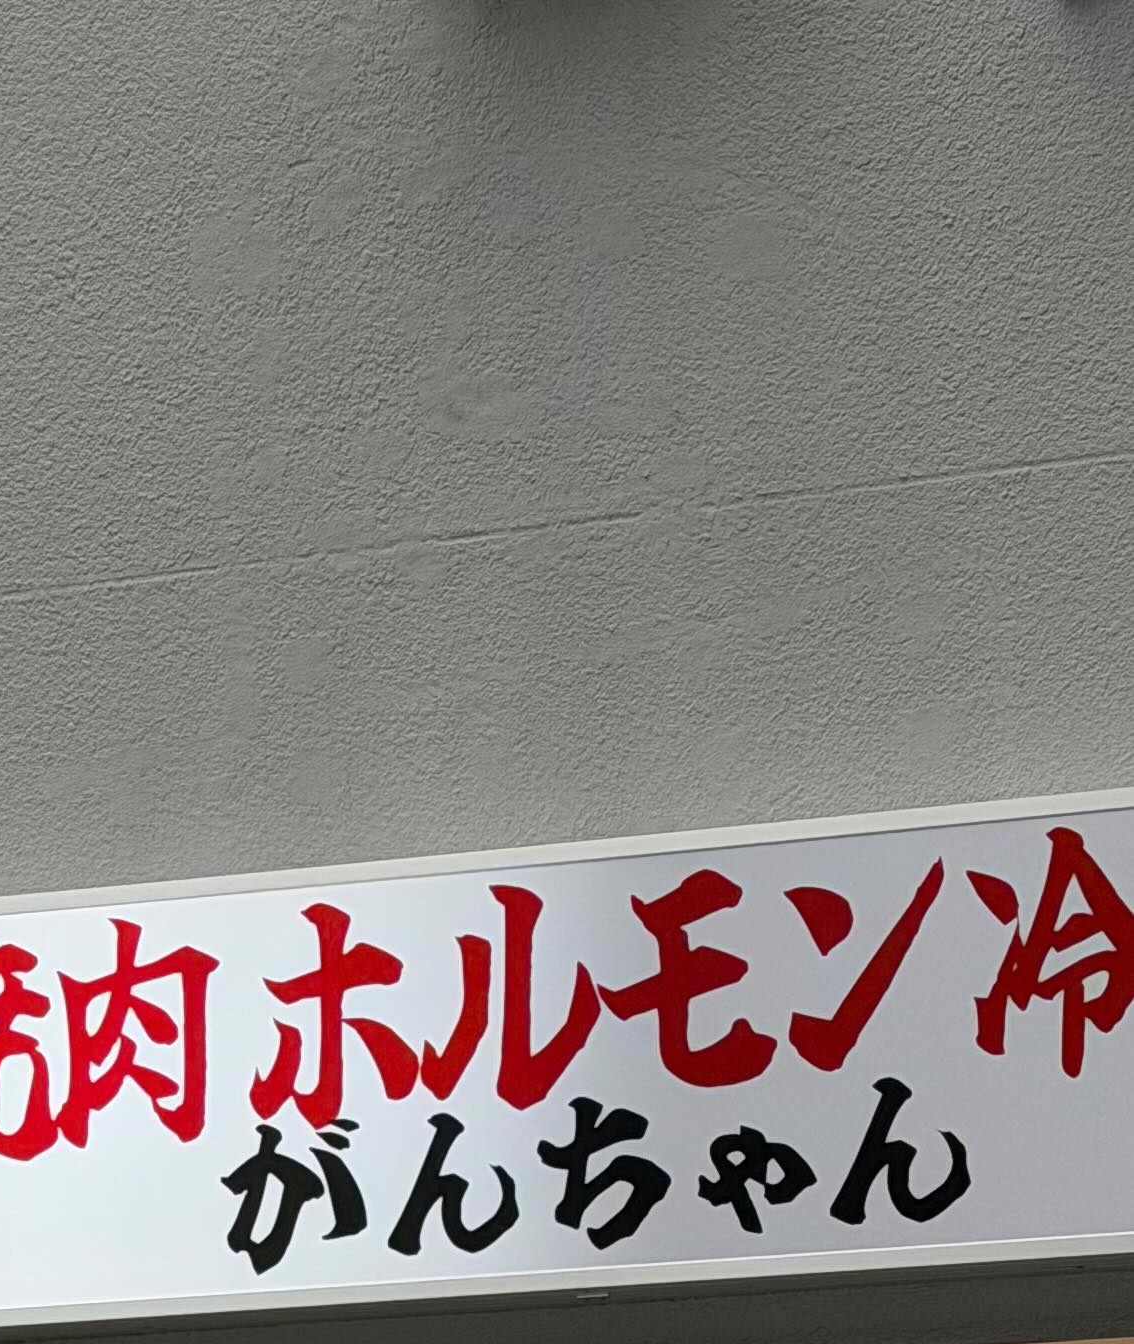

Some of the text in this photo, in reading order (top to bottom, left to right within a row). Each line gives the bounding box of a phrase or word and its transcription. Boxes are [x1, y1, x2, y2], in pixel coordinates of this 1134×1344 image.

[220, 1076, 971, 1275] がんちゃん
